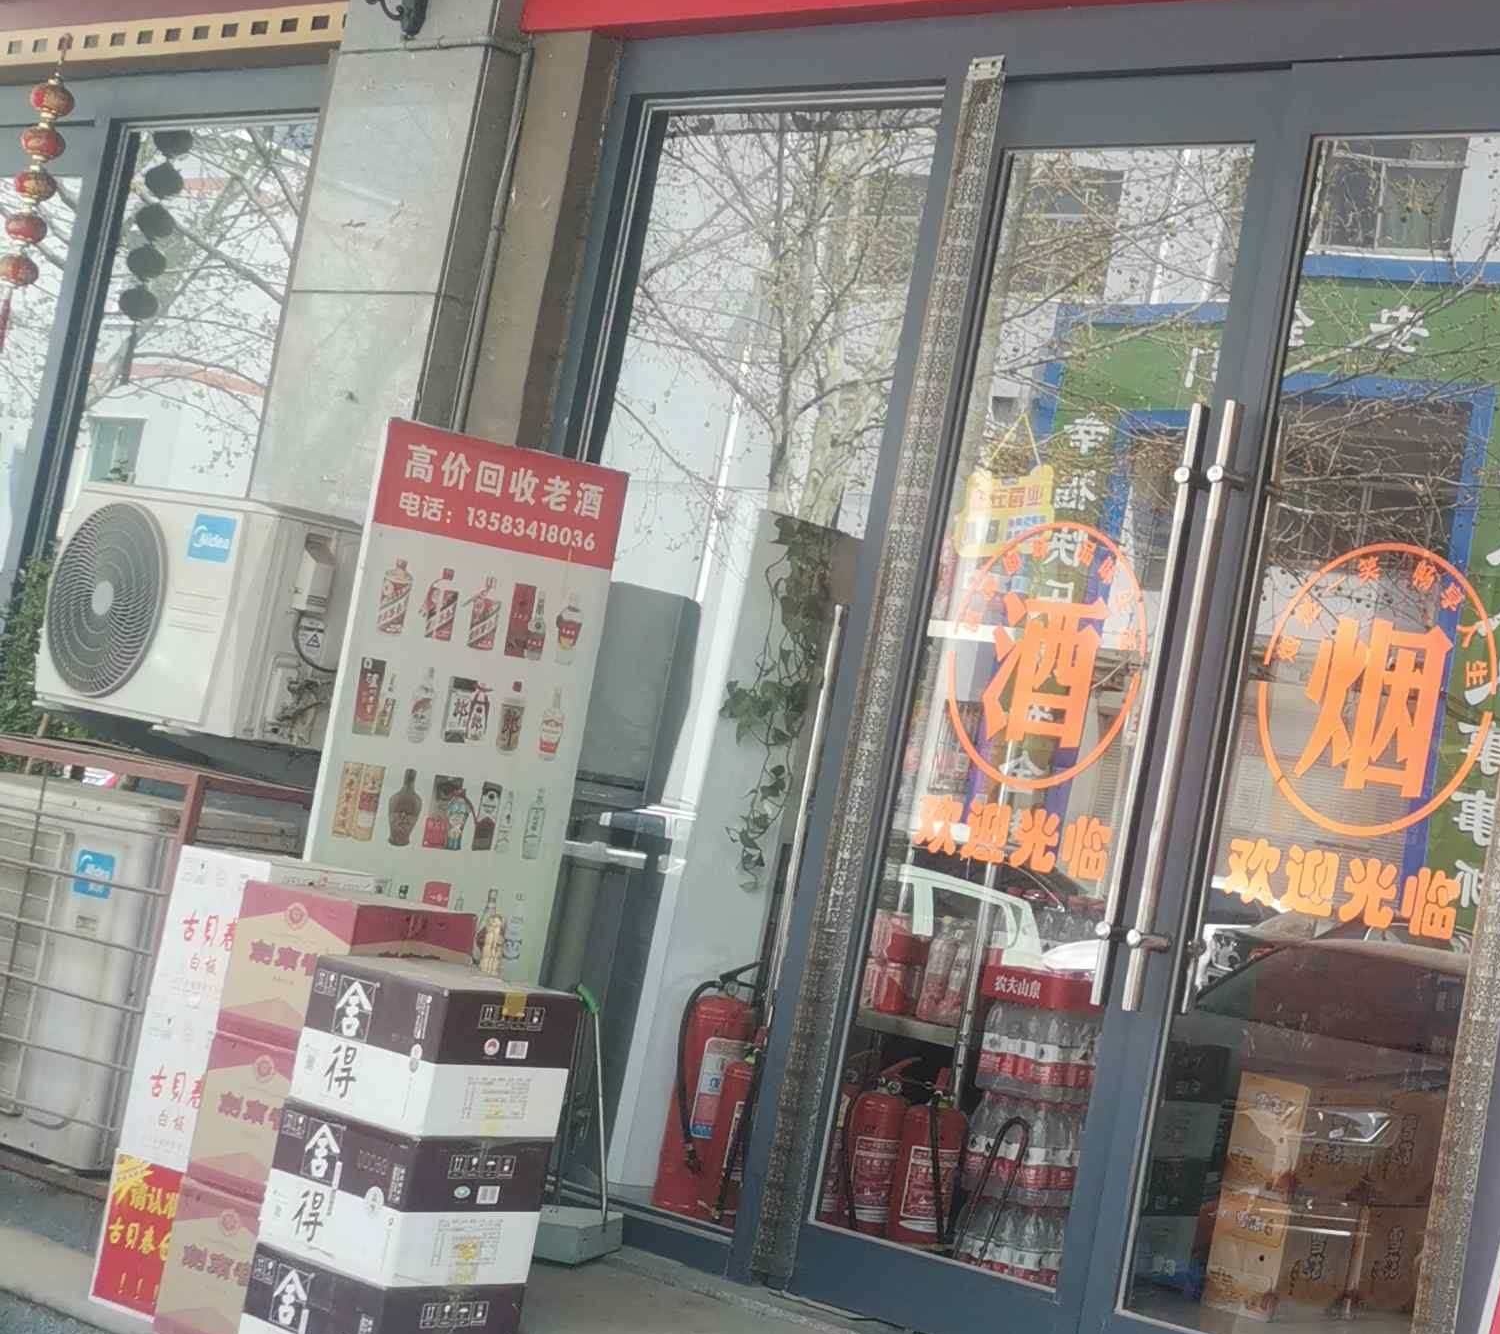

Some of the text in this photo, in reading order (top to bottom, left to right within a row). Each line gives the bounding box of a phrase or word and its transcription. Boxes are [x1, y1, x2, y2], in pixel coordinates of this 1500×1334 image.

[404, 443, 605, 521] 高价回收老酒
[466, 506, 596, 551] 13583418036
[983, 593, 1109, 748] 酒
[1294, 618, 1454, 798] 烟
[911, 794, 1113, 882] 欢迎光临
[1224, 836, 1463, 940] 欢迎光临
[994, 974, 1041, 1000] 农夫山泉
